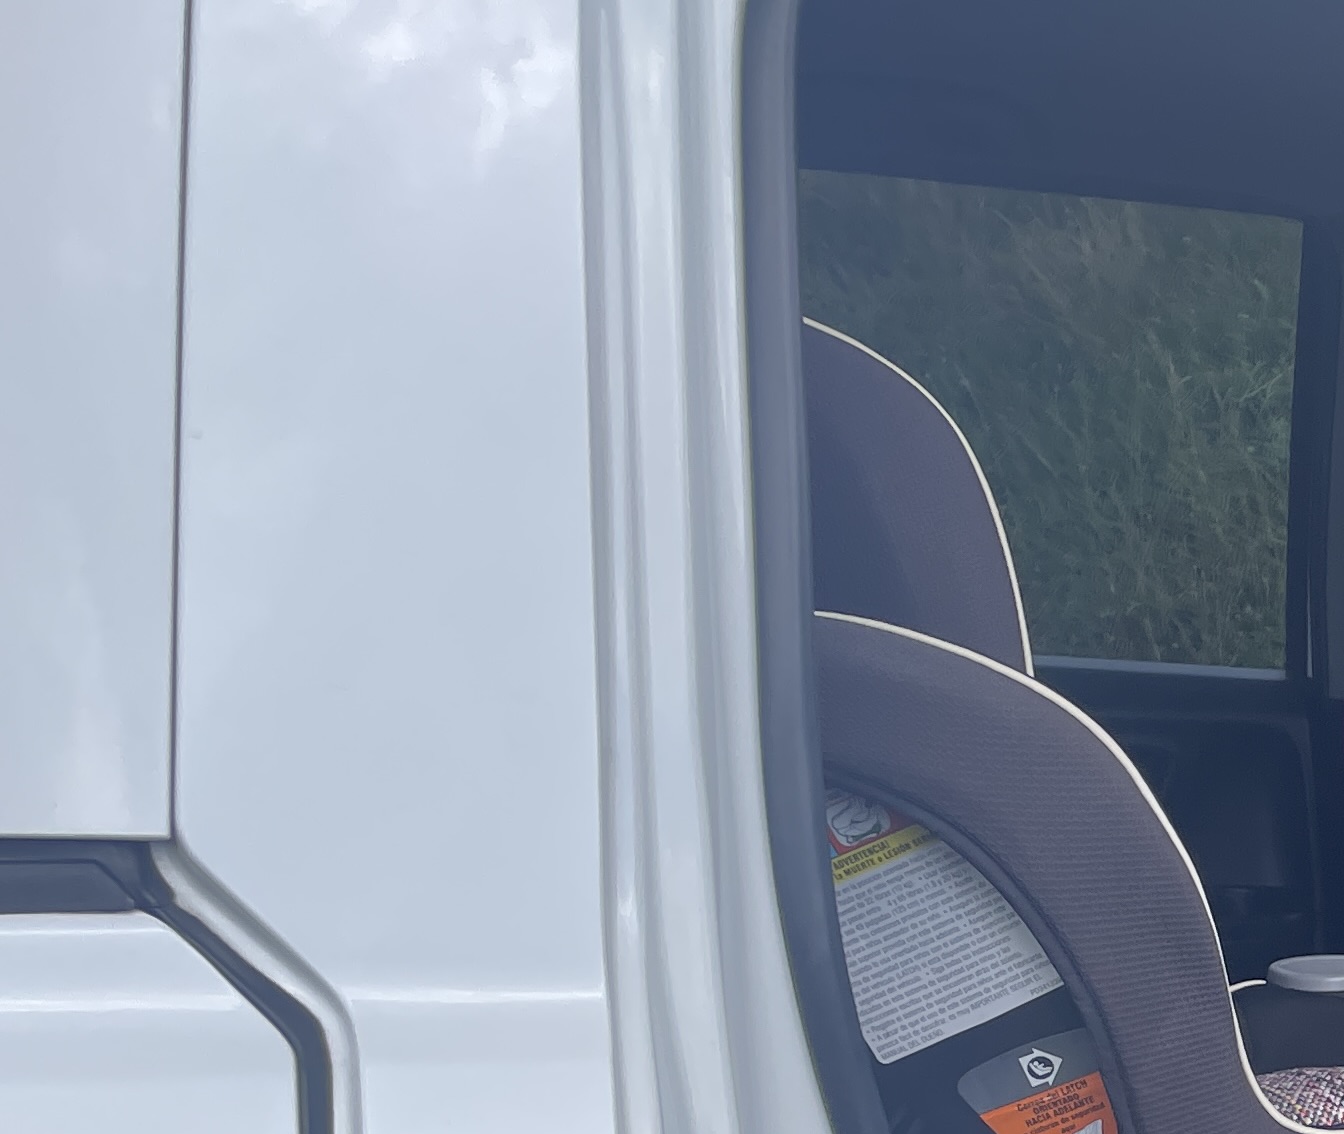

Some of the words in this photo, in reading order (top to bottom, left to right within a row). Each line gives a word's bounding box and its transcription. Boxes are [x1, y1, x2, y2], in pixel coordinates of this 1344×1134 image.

[833, 839, 891, 870] ADVERTENCIA!
[843, 857, 876, 876] MUERTE
[1061, 1079, 1088, 1095] LATCH
[1026, 1112, 1050, 1126] HACIA
[1053, 1095, 1094, 1116] ADELANTE
[1033, 1092, 1079, 1114] ORIENTADO
